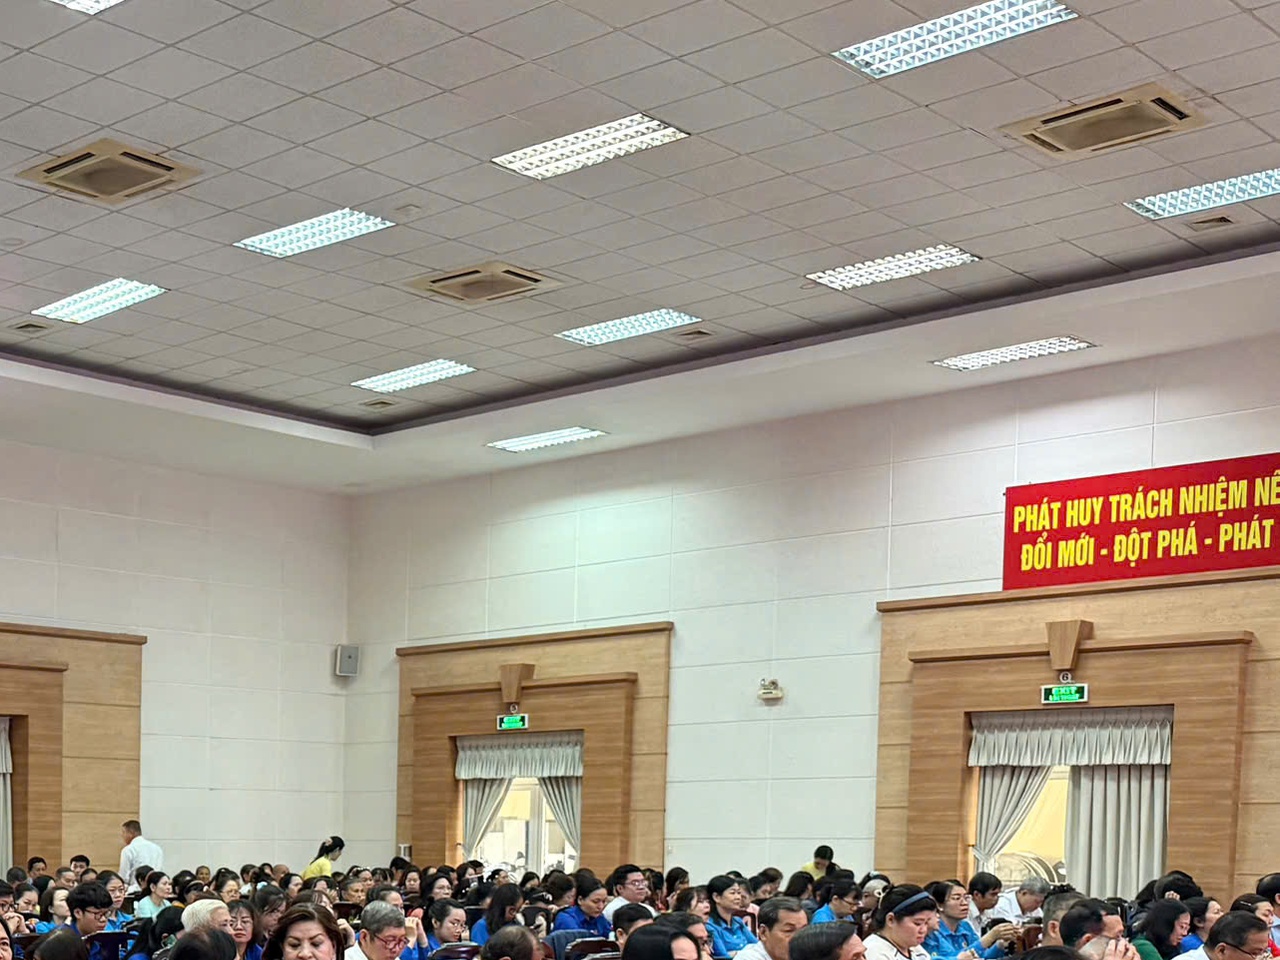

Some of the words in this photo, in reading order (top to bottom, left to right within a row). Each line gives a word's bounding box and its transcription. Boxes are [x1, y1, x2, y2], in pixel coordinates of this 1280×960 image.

[1013, 497, 1061, 533] PHÁT
[1066, 497, 1104, 528] HUY
[1109, 485, 1173, 523] TRÁCH
[1179, 476, 1248, 517] NHIỆM
[1021, 532, 1052, 571] ĐỔI
[1058, 532, 1095, 568] MỚI
[1113, 527, 1152, 567] ĐỘT
[1157, 521, 1198, 558] PHÁ
[1219, 514, 1275, 552] PHÁT
